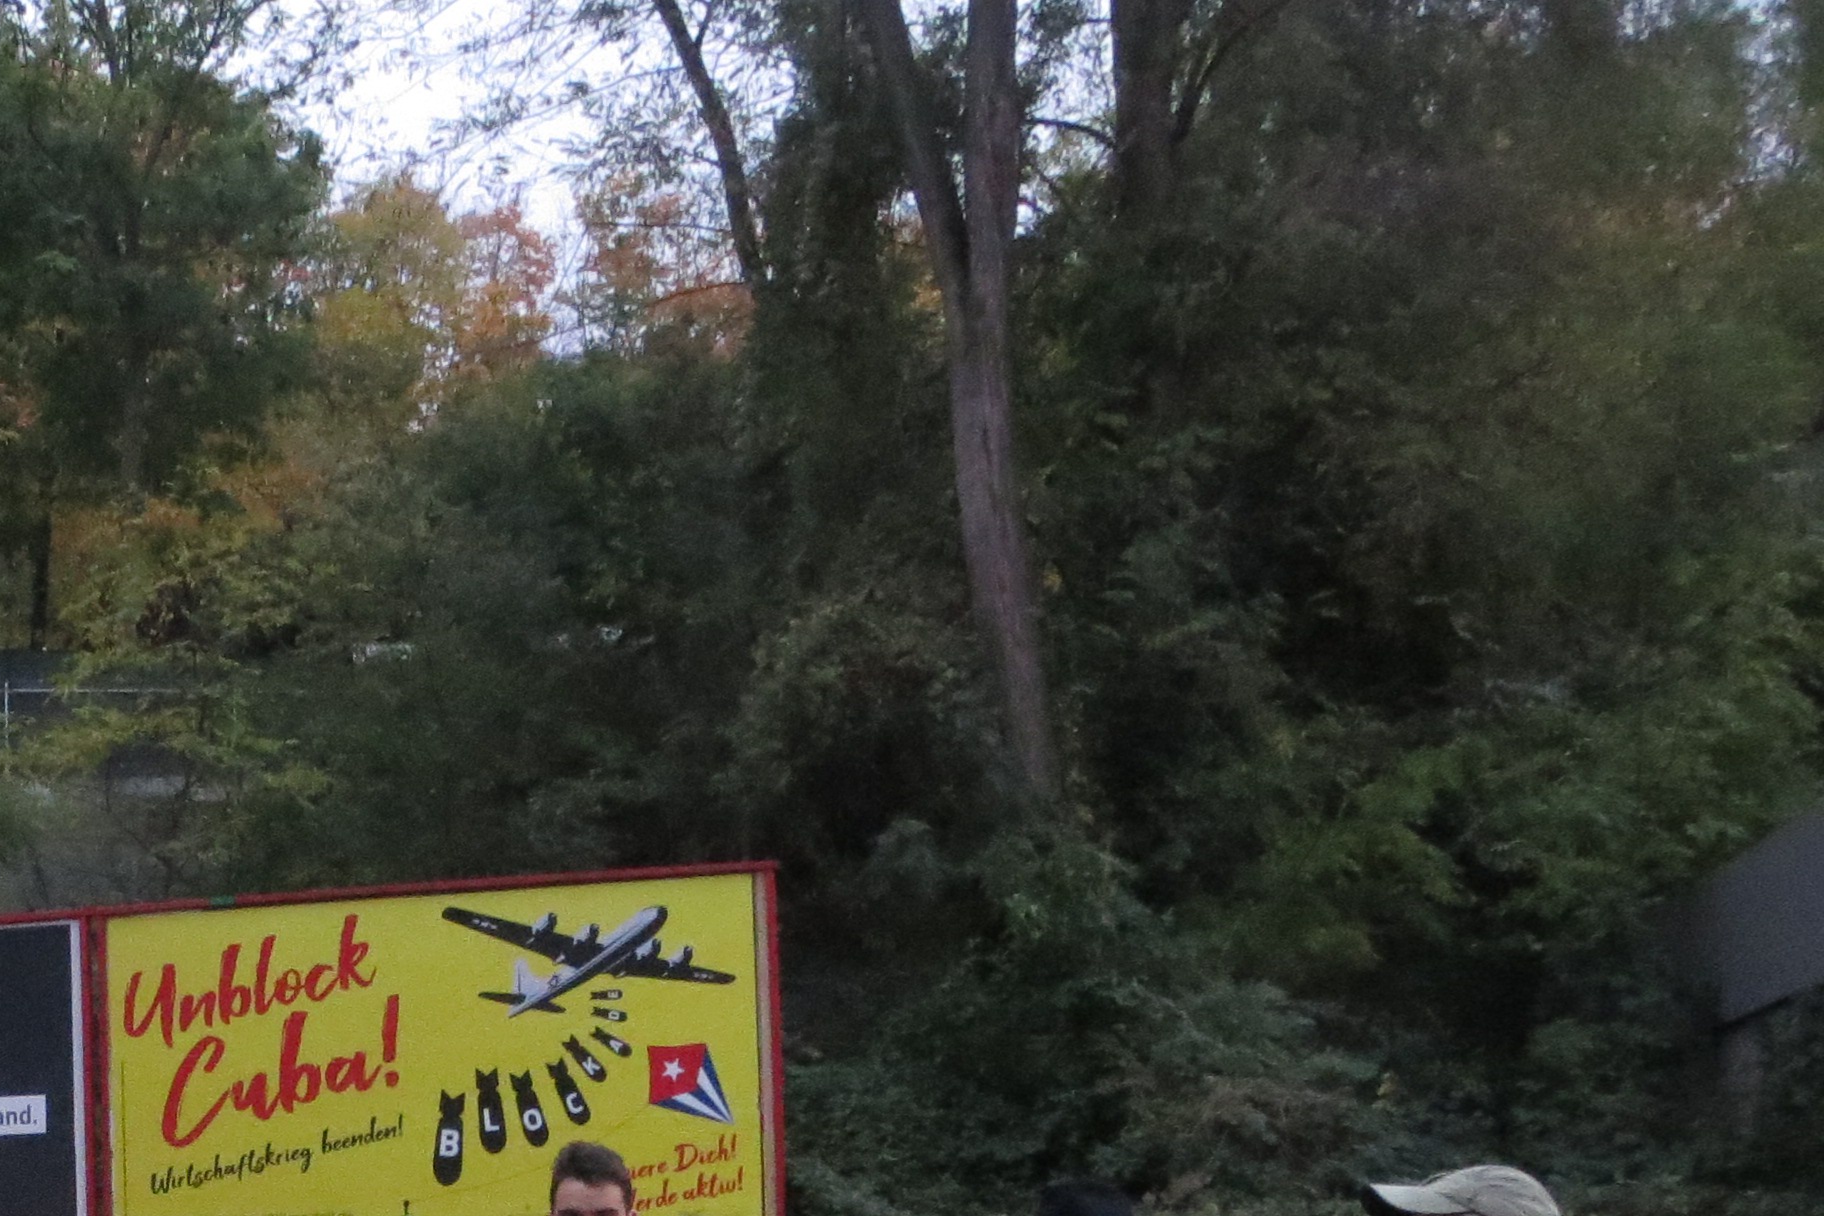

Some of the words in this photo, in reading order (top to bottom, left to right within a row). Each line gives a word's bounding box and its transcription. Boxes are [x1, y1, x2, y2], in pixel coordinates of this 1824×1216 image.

[124, 914, 377, 1048] Unblock
[162, 994, 400, 1148] Cuba!
[150, 1142, 312, 1194] Wirtschaftskrieg
[321, 1114, 404, 1154] beenden!
[674, 1133, 737, 1172] Dich!
[683, 1166, 744, 1201] aktiv!
